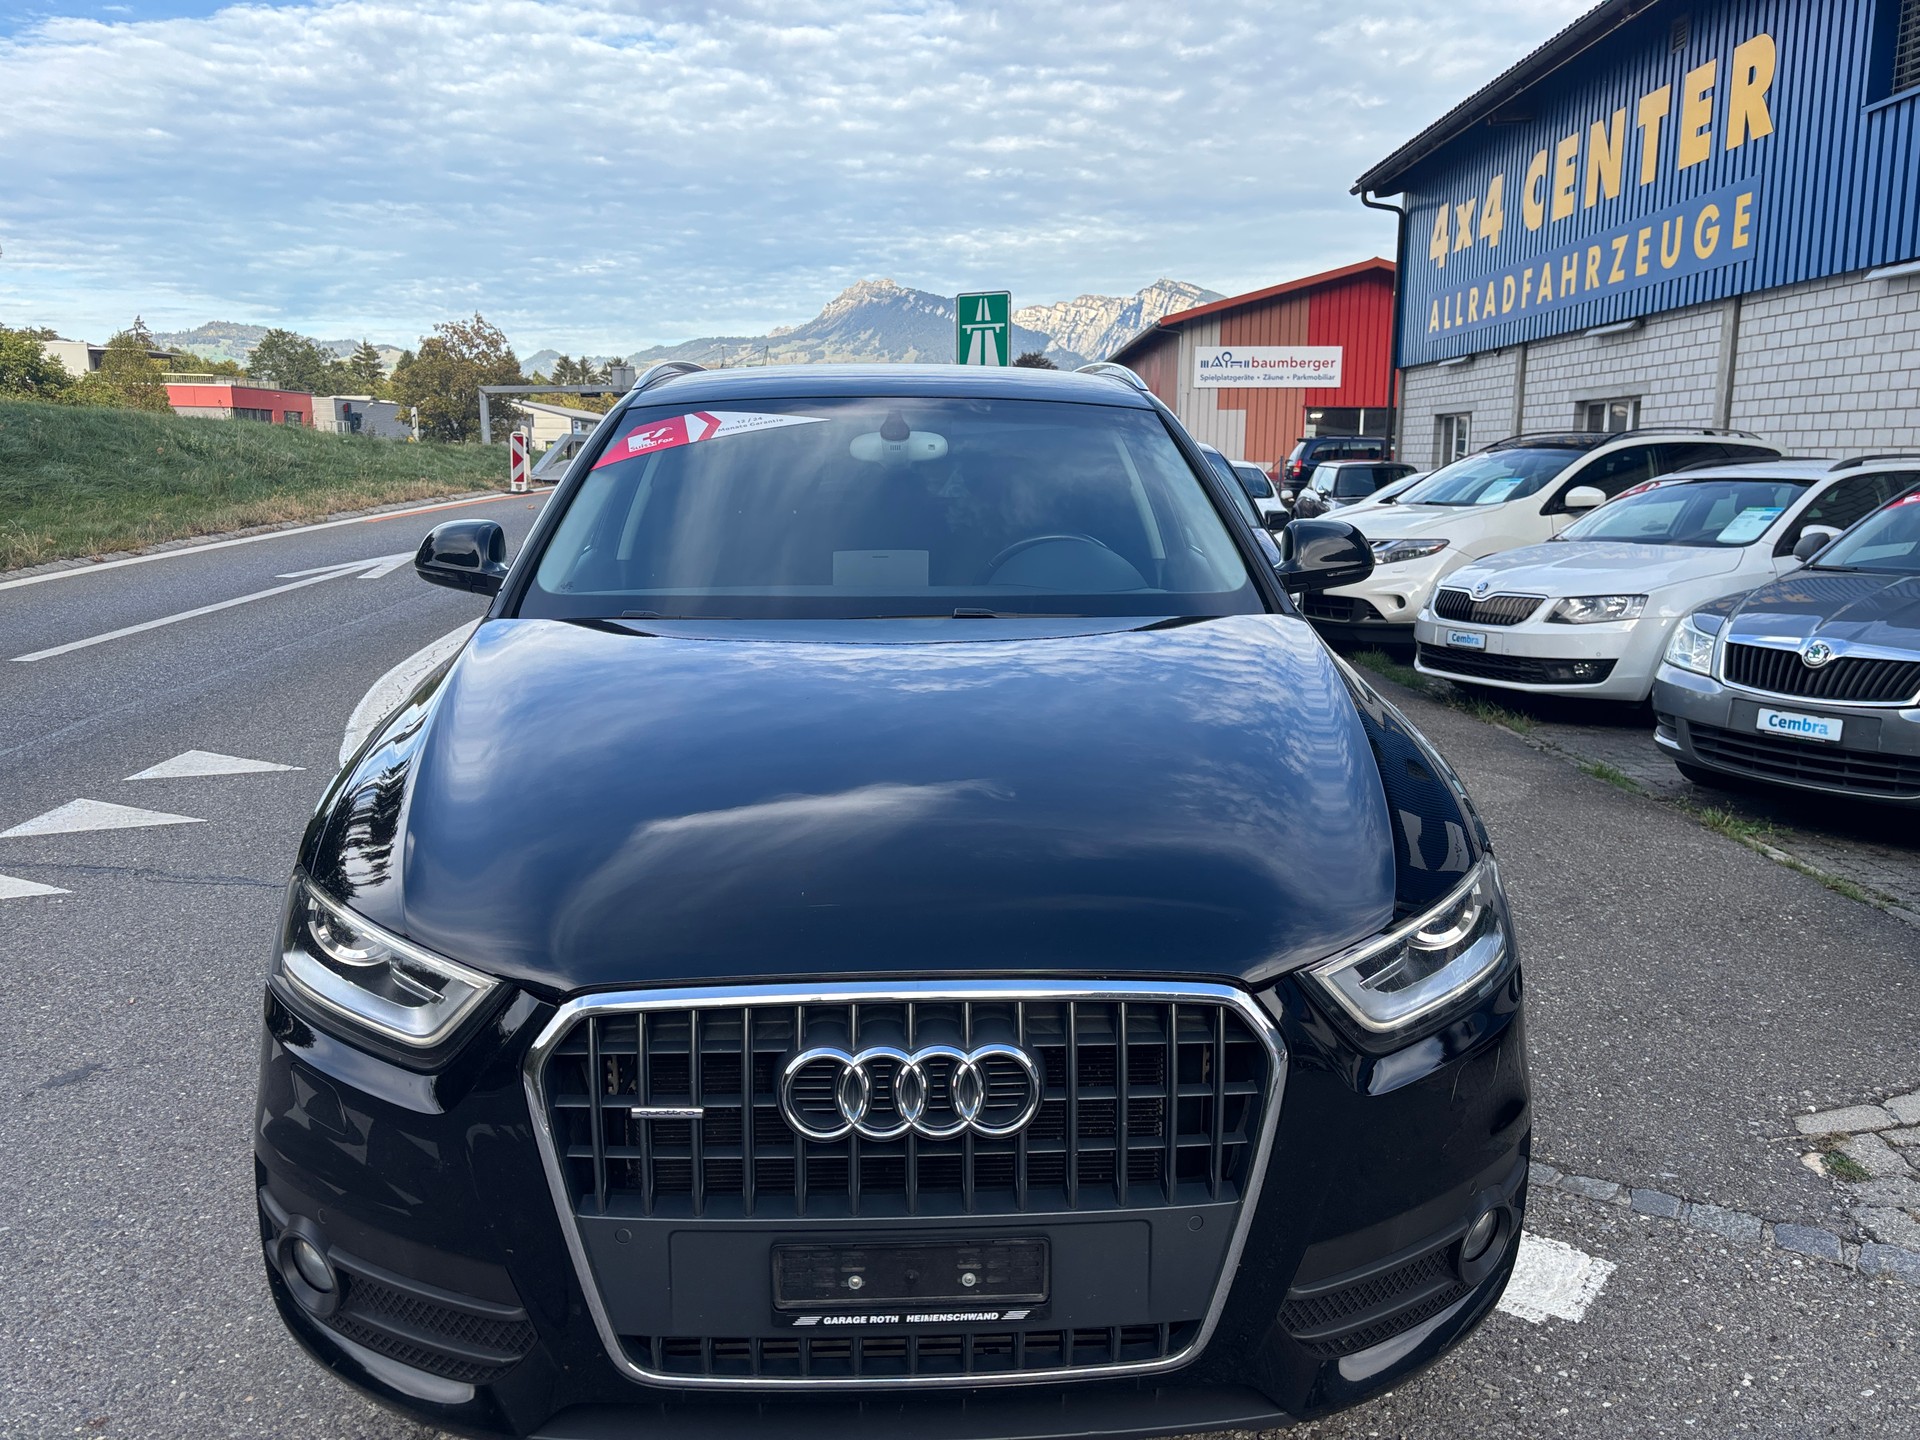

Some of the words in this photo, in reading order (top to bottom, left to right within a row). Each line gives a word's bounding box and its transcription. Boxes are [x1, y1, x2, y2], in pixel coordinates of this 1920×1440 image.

[1429, 173, 1503, 269] 4x4
[1522, 32, 1776, 232] CENTER
[1428, 192, 1753, 333] ALLRADFAHRZEUGE
[1251, 356, 1336, 371] baumberger
[1200, 373, 1254, 382] Spielplatzgeräte
[749, 418, 784, 427] Garantie
[1451, 633, 1480, 645] Cembra
[1768, 714, 1829, 735] Cembra
[823, 1316, 867, 1325] GARAGE
[869, 1315, 899, 1324] ROTH
[906, 1312, 999, 1323] HEIMENSCHWAND
